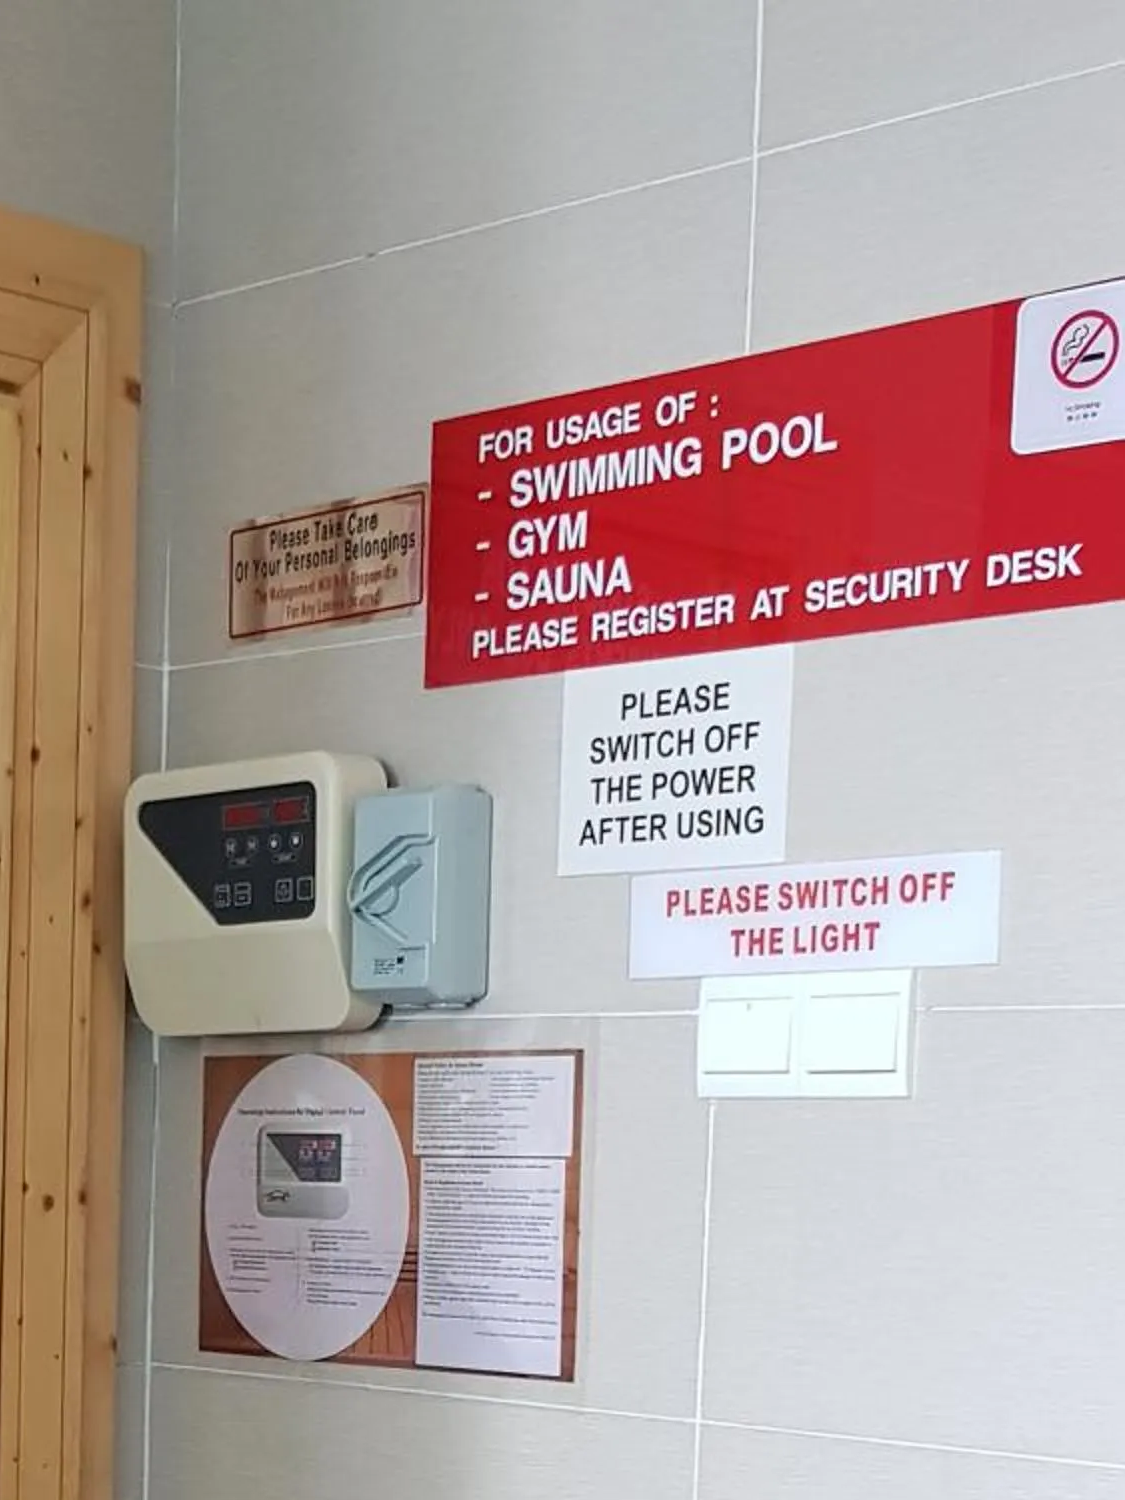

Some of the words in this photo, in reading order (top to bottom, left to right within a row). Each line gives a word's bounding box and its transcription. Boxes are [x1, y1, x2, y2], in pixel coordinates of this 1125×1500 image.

[478, 427, 533, 463] FOR
[545, 403, 641, 449] USAGE
[656, 391, 698, 428] OF
[509, 436, 702, 510] SWIMMING
[722, 412, 838, 471] POOL
[270, 529, 310, 551] Please
[314, 519, 343, 542] Take
[348, 512, 378, 535] Care
[507, 511, 589, 560] GYM
[235, 561, 248, 583] Of
[253, 559, 281, 579] Your
[285, 547, 339, 573] Personal
[344, 530, 416, 562] Belongings
[472, 622, 578, 660] PLEASE
[591, 594, 735, 642] REGISTER
[750, 585, 789, 621] AT
[804, 559, 970, 614] SECURITY
[986, 544, 1083, 587] DESK
[506, 555, 632, 611] SAUNA
[621, 682, 731, 721] PLEASE
[590, 729, 694, 765] SWITCH
[704, 721, 760, 754] OFF
[591, 774, 642, 805] THE
[651, 764, 755, 800] POWER
[579, 813, 667, 846] AFTER
[676, 805, 764, 839] USING
[666, 884, 769, 918] PLEASE
[778, 875, 889, 911] SWITCH
[898, 871, 956, 902] OFF
[730, 928, 784, 957] THE
[793, 922, 880, 954] LIGHT
